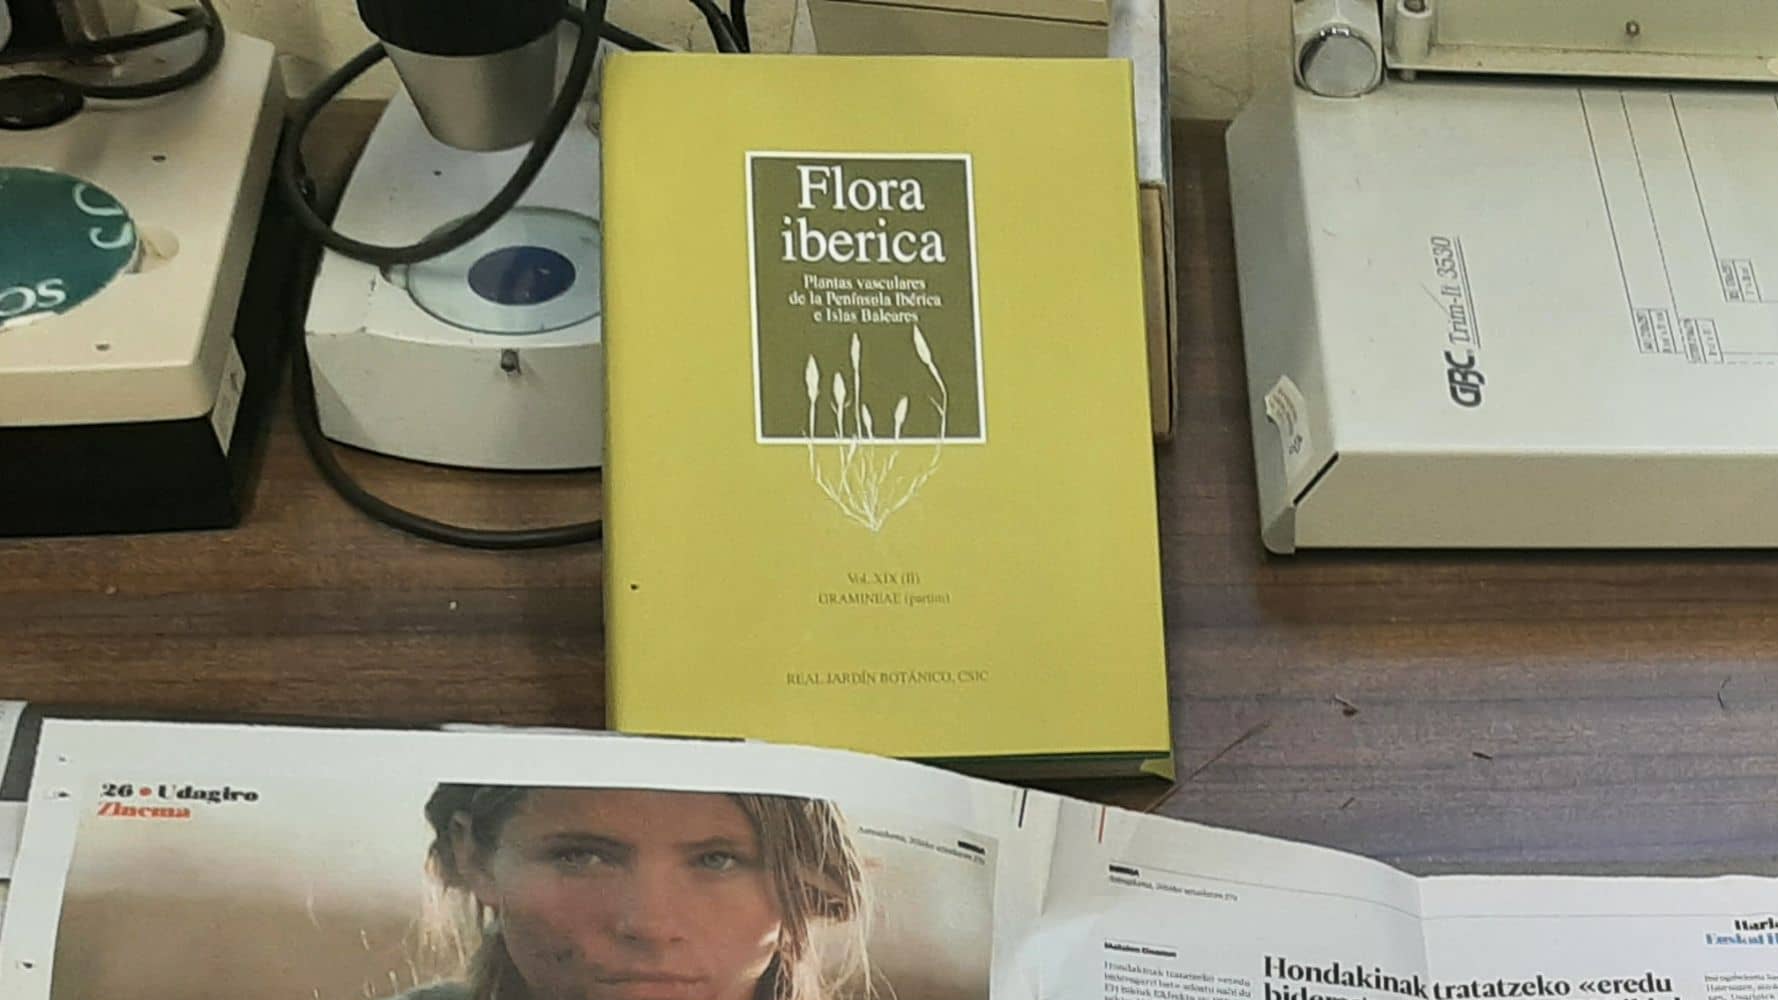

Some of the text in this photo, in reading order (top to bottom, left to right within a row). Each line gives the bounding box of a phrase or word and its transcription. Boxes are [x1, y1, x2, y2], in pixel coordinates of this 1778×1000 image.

[796, 165, 926, 211] Flora
[781, 215, 947, 263] iberica
[803, 273, 926, 290] Plantas vasculares
[788, 290, 806, 305] de
[809, 290, 823, 306] la
[895, 291, 943, 307] Ibérica
[813, 308, 919, 323] e Islas Baleares
[1430, 235, 1486, 406] GBC Trim-It 3530
[874, 572, 898, 585] XIX
[817, 592, 901, 605] GRAMINEAE
[786, 672, 823, 686] REAL
[826, 669, 877, 685] JARDÍN
[957, 670, 989, 682] CSIC
[102, 784, 259, 803] 26 Udagiro
[97, 802, 191, 818] Zinema
[1705, 931, 1764, 945] Euskal
[1264, 956, 1673, 1000] Hondakinak tratatzeko «eredu
